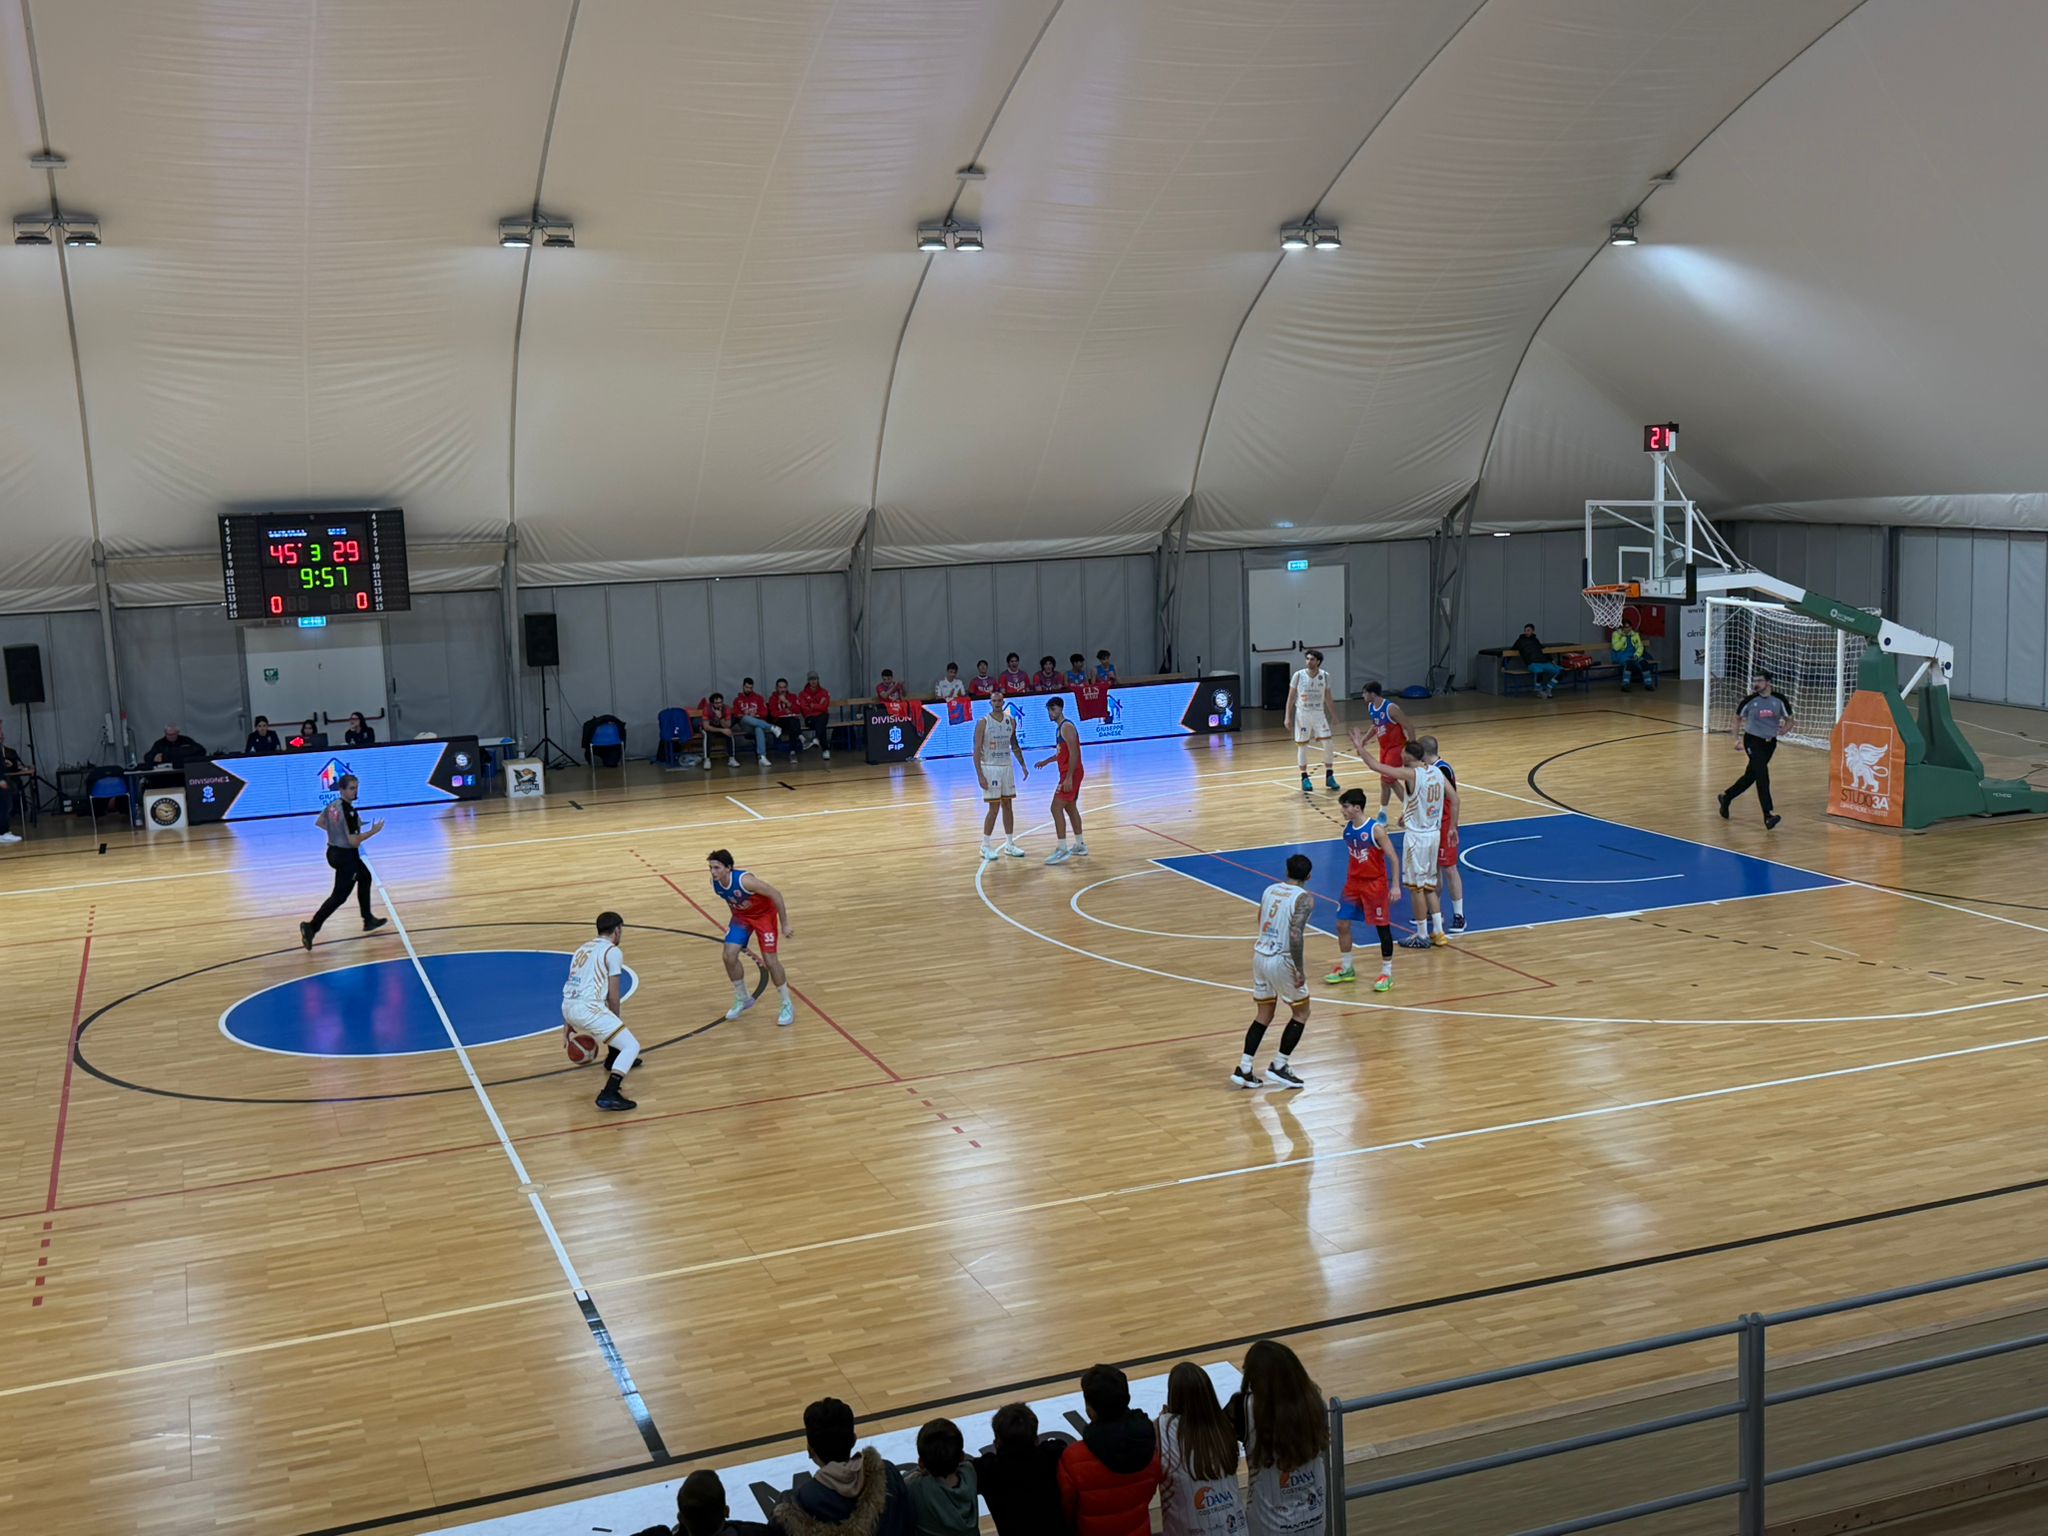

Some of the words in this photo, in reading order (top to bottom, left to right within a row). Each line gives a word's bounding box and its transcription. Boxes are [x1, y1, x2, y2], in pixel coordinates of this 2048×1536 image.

[1651, 427, 1669, 449] 21
[224, 518, 230, 526] 4
[372, 521, 377, 529] 5
[225, 527, 230, 535] 5
[227, 552, 232, 560] 8
[270, 543, 297, 564] 45
[310, 544, 321, 561] 3
[333, 540, 359, 562] 29
[225, 569, 235, 577] 10
[300, 566, 348, 589] 9:57
[226, 577, 235, 585] 11
[229, 602, 237, 610] 14
[270, 595, 283, 613] 0
[356, 591, 368, 609] 0
[375, 603, 383, 611] 15
[887, 743, 904, 751] FIP
[1426, 783, 1441, 803] 00
[1205, 1490, 1233, 1508] DANA
